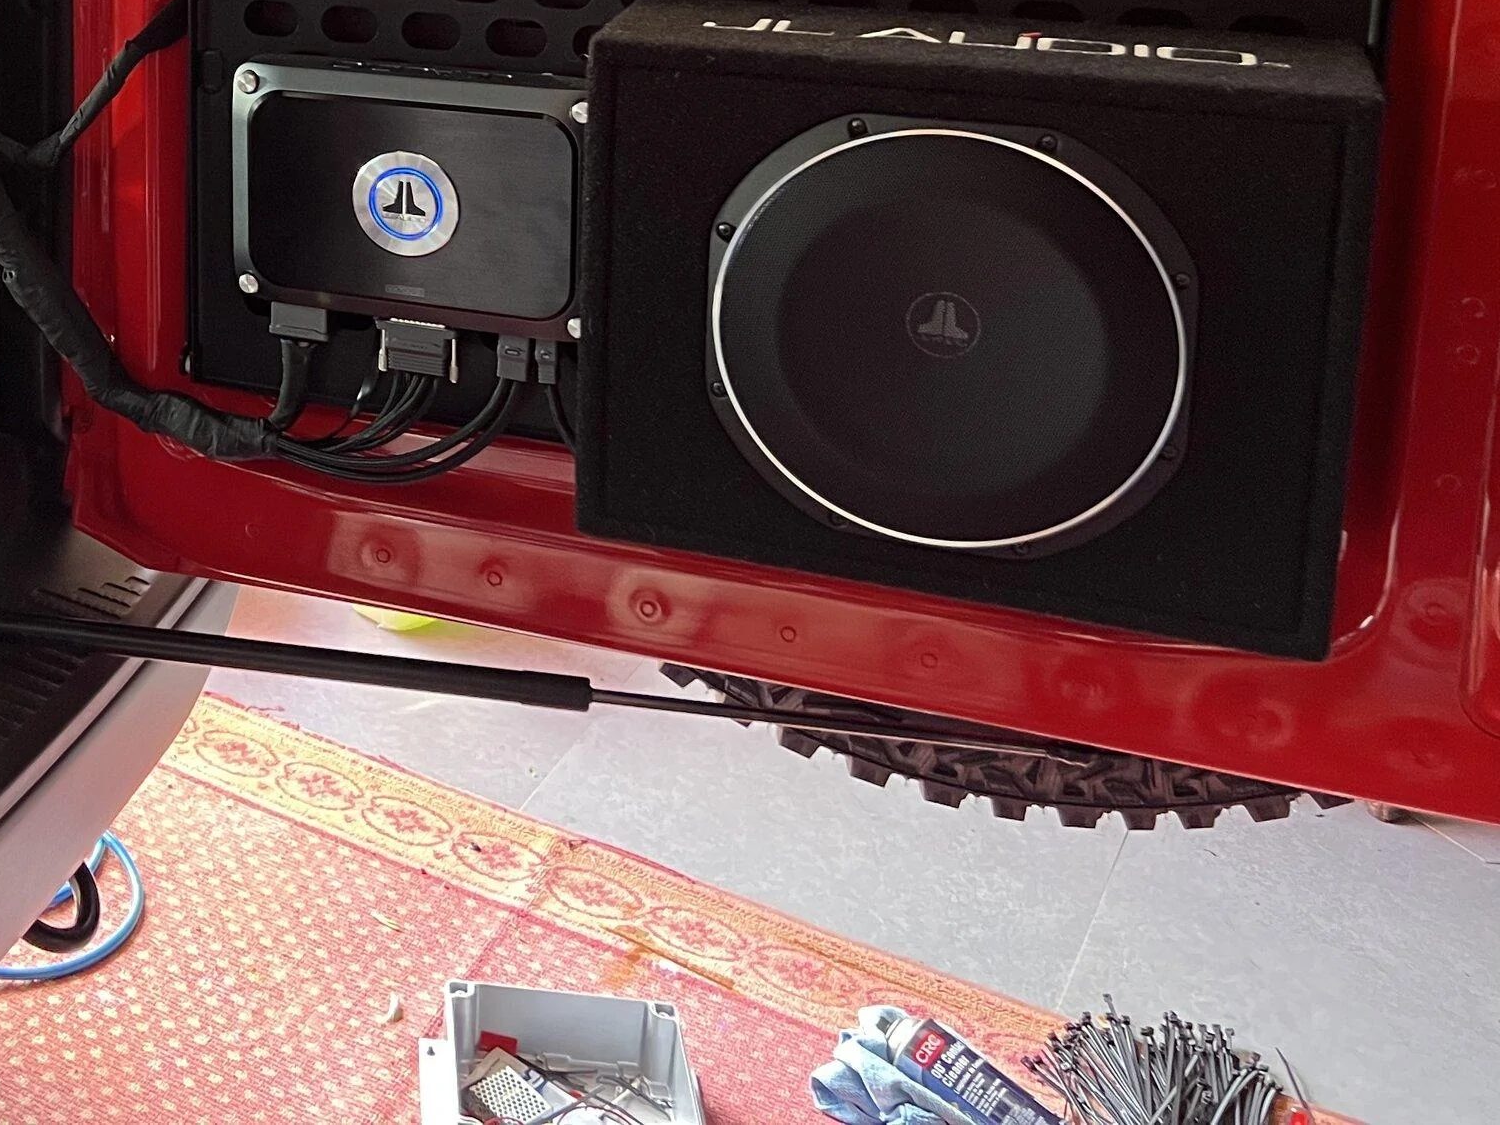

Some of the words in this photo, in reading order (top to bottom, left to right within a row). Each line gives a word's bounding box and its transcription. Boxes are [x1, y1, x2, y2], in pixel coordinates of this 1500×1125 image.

[703, 18, 835, 37] JL
[856, 26, 1258, 67] AUDIO
[915, 1033, 942, 1065] CRC
[942, 1055, 971, 1088] Cleaner
